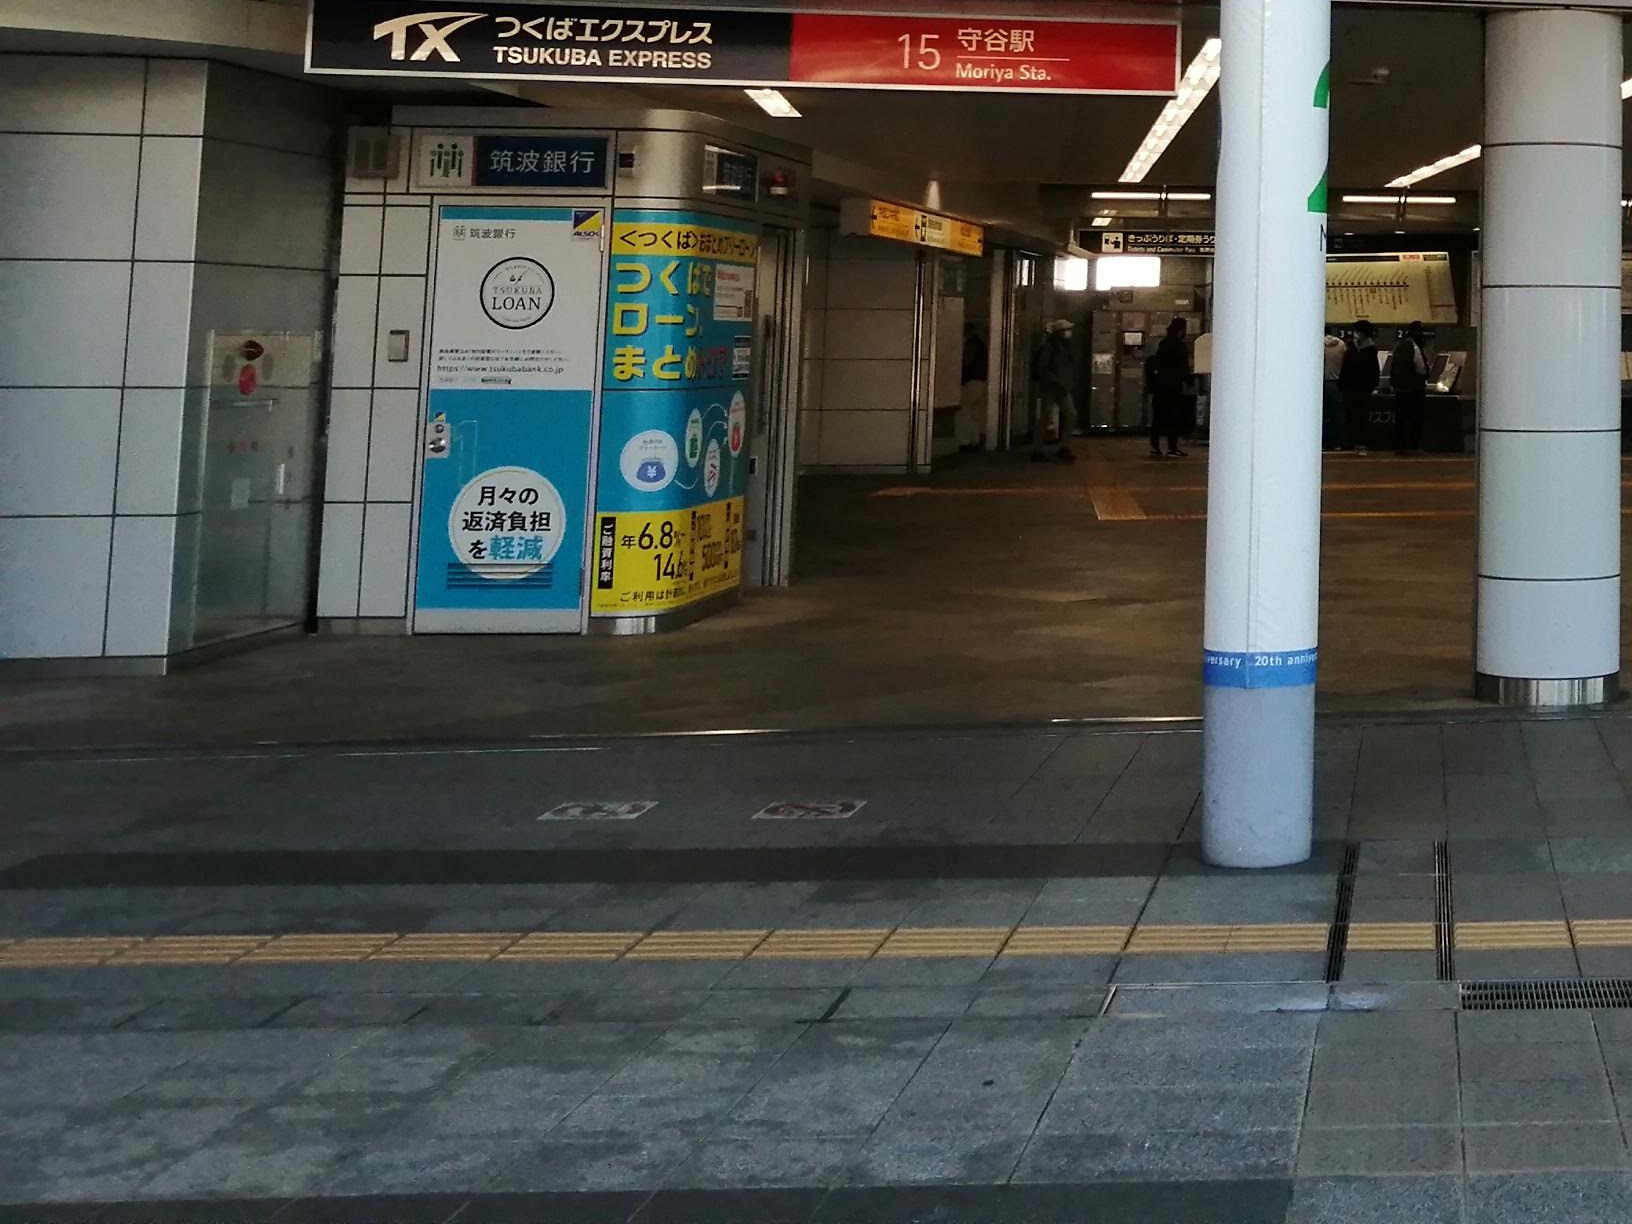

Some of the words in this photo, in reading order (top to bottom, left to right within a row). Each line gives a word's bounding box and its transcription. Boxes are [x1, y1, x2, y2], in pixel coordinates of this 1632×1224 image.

[373, 11, 490, 63] TX
[494, 16, 714, 46] つくばエクスプレス
[956, 27, 1035, 54] 守谷駅
[493, 46, 603, 67] TSUKUBA
[608, 50, 713, 70] EXPRESS
[898, 33, 942, 71] 15
[955, 62, 1014, 83] Moriya
[1019, 63, 1052, 81] Sta.
[489, 149, 597, 175] 筑波銀行
[469, 227, 517, 240] 筑波銀行
[493, 286, 543, 295] TSUKUBA
[491, 296, 542, 311] LOAN
[477, 485, 539, 506] 月々の
[461, 510, 552, 532] 返済負担
[468, 534, 544, 561] を軽減
[1254, 655, 1282, 667] 20th
